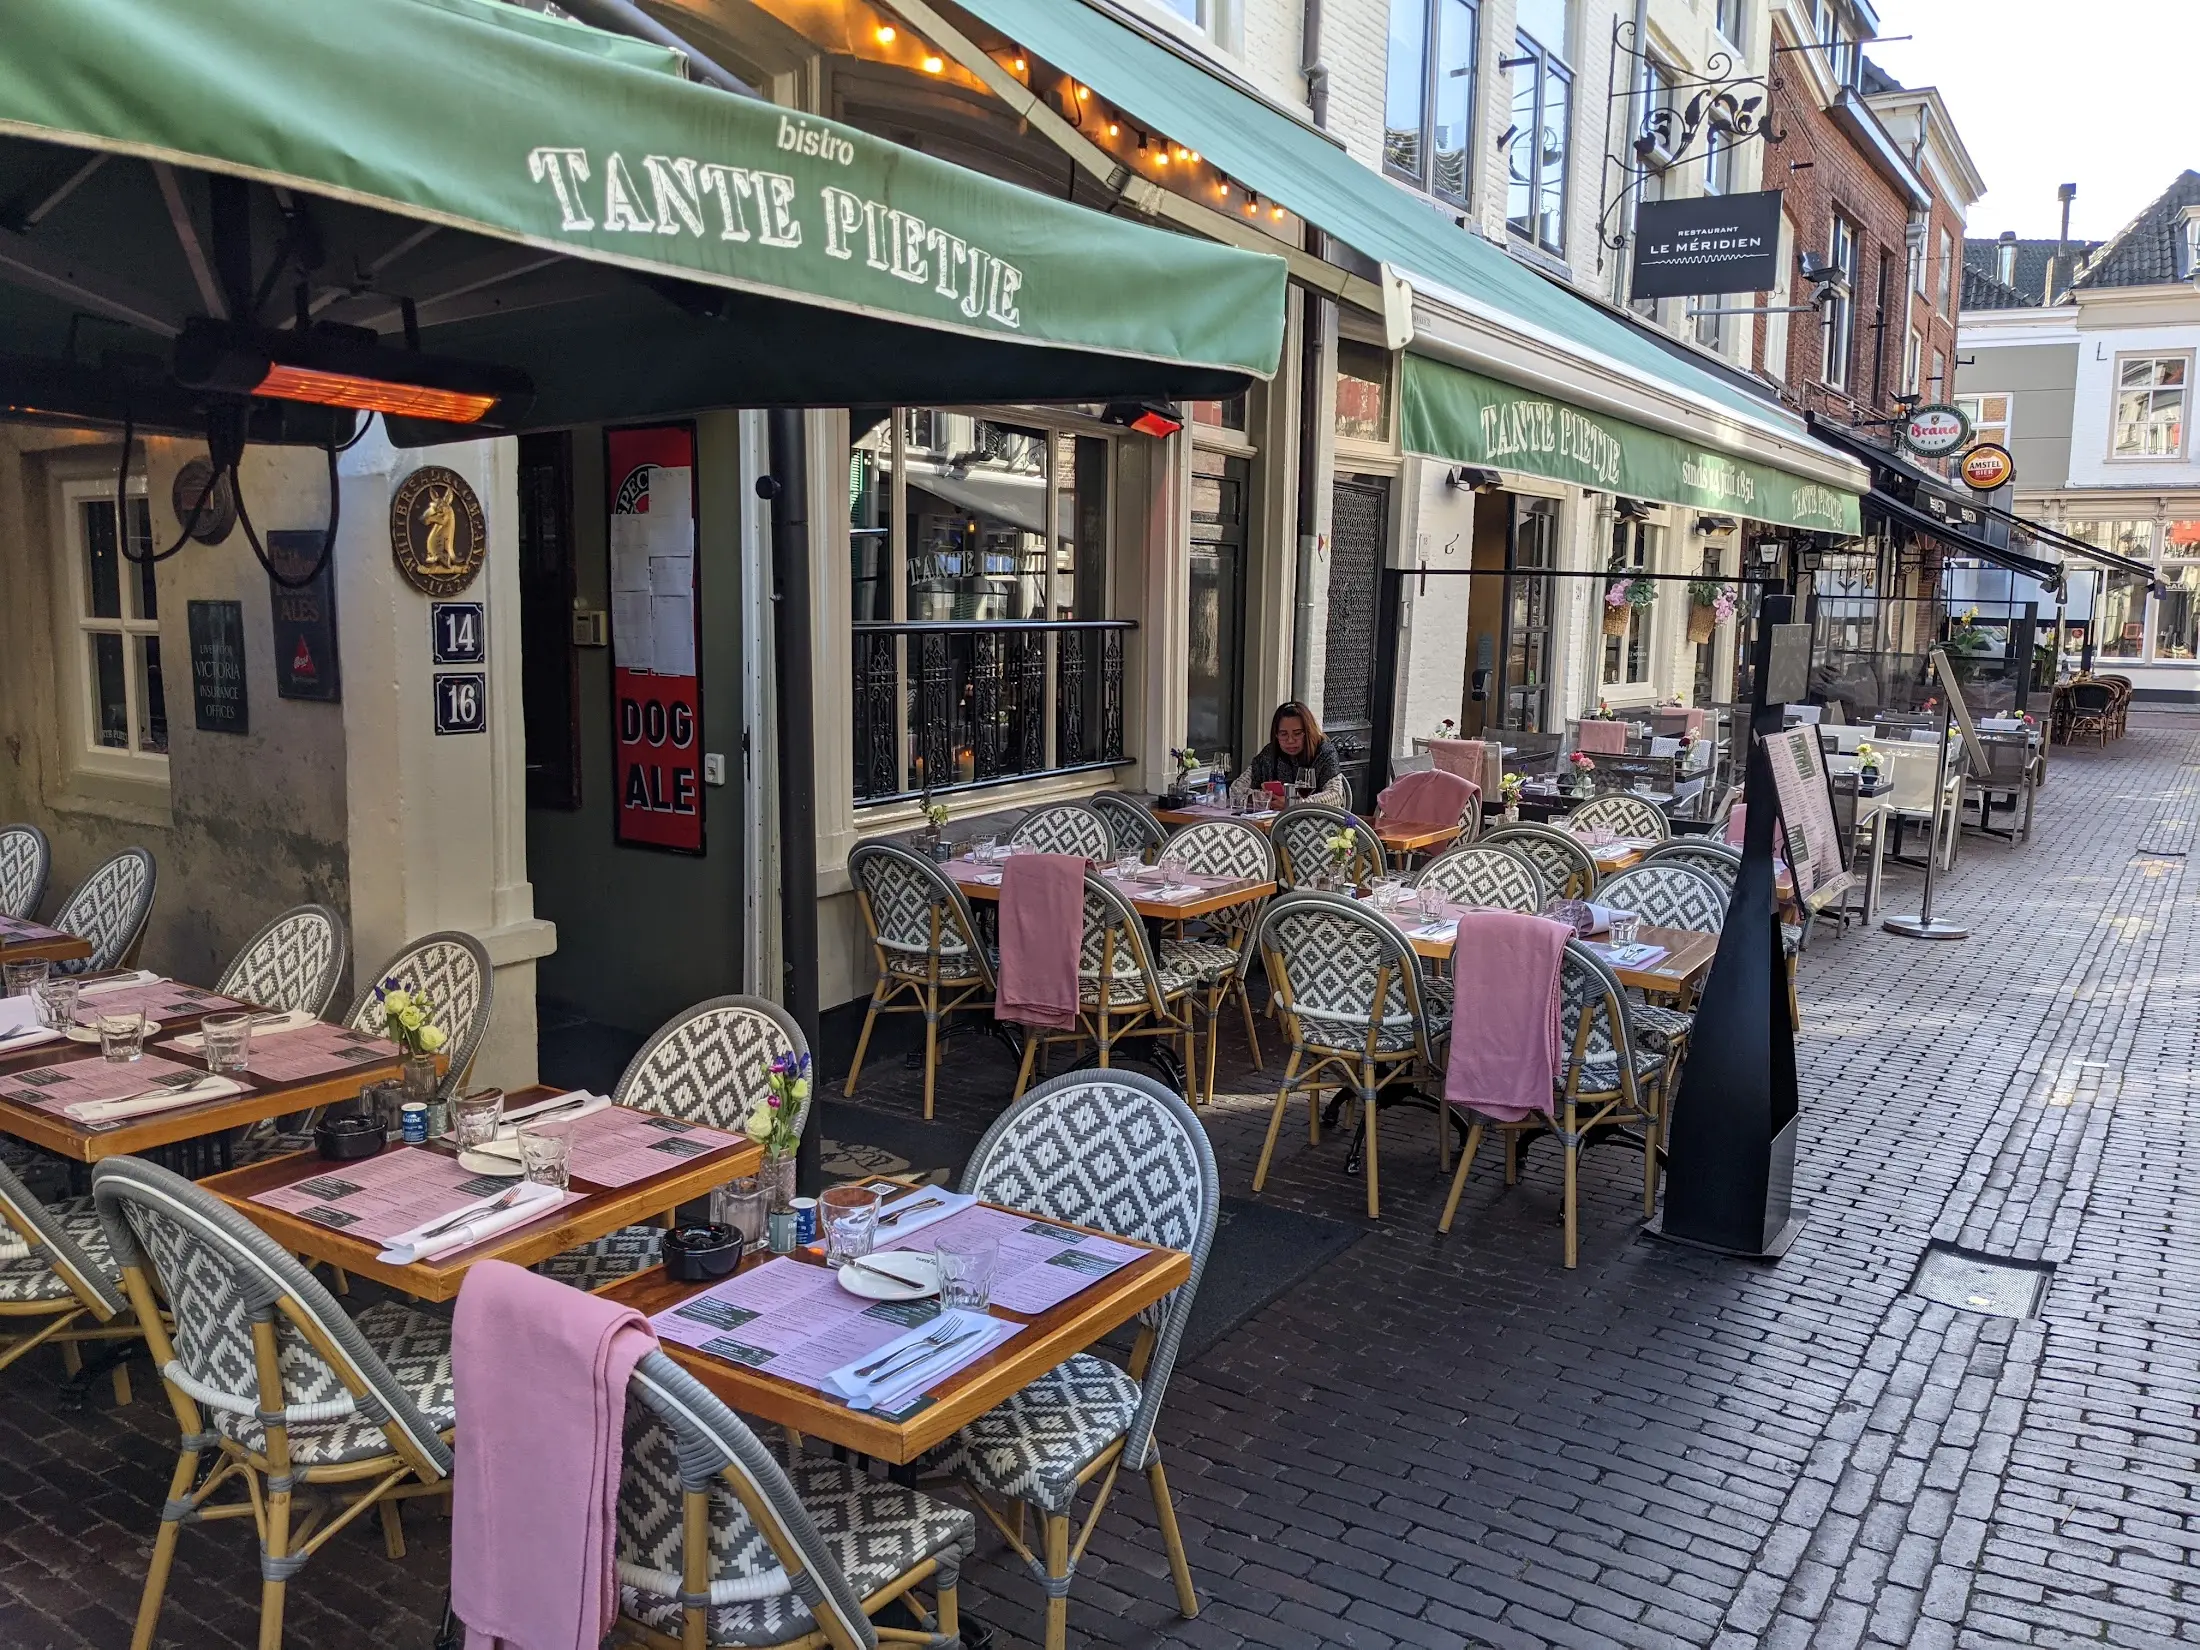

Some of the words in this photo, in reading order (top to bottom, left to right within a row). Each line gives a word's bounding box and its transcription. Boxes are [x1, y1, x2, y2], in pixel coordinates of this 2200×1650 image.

[778, 115, 854, 165] bistro
[529, 146, 801, 249] TANTE
[820, 185, 1023, 329] PIETJE
[1650, 244, 1669, 254] LE
[1676, 237, 1761, 252] MÉRIDIEN
[1678, 226, 1739, 236] RESTAURANT
[1481, 400, 1554, 459] TANTE
[1560, 406, 1620, 484] PIETJE
[1911, 423, 1959, 438] Brand
[1682, 454, 1707, 488] sinds
[1719, 463, 1735, 500] juli
[1736, 471, 1754, 504] 1851
[1969, 461, 2001, 469] AMSTEL
[1792, 485, 1818, 520] TANTE
[907, 550, 974, 586] TANTE
[280, 600, 319, 622] ALES
[446, 613, 475, 652] 14
[196, 660, 240, 680] VICTORIA
[200, 685, 239, 700] INSURANCE
[449, 683, 476, 723] 16
[206, 704, 235, 718] OFFICES
[621, 698, 693, 749] DOG
[624, 763, 696, 814] ALE
